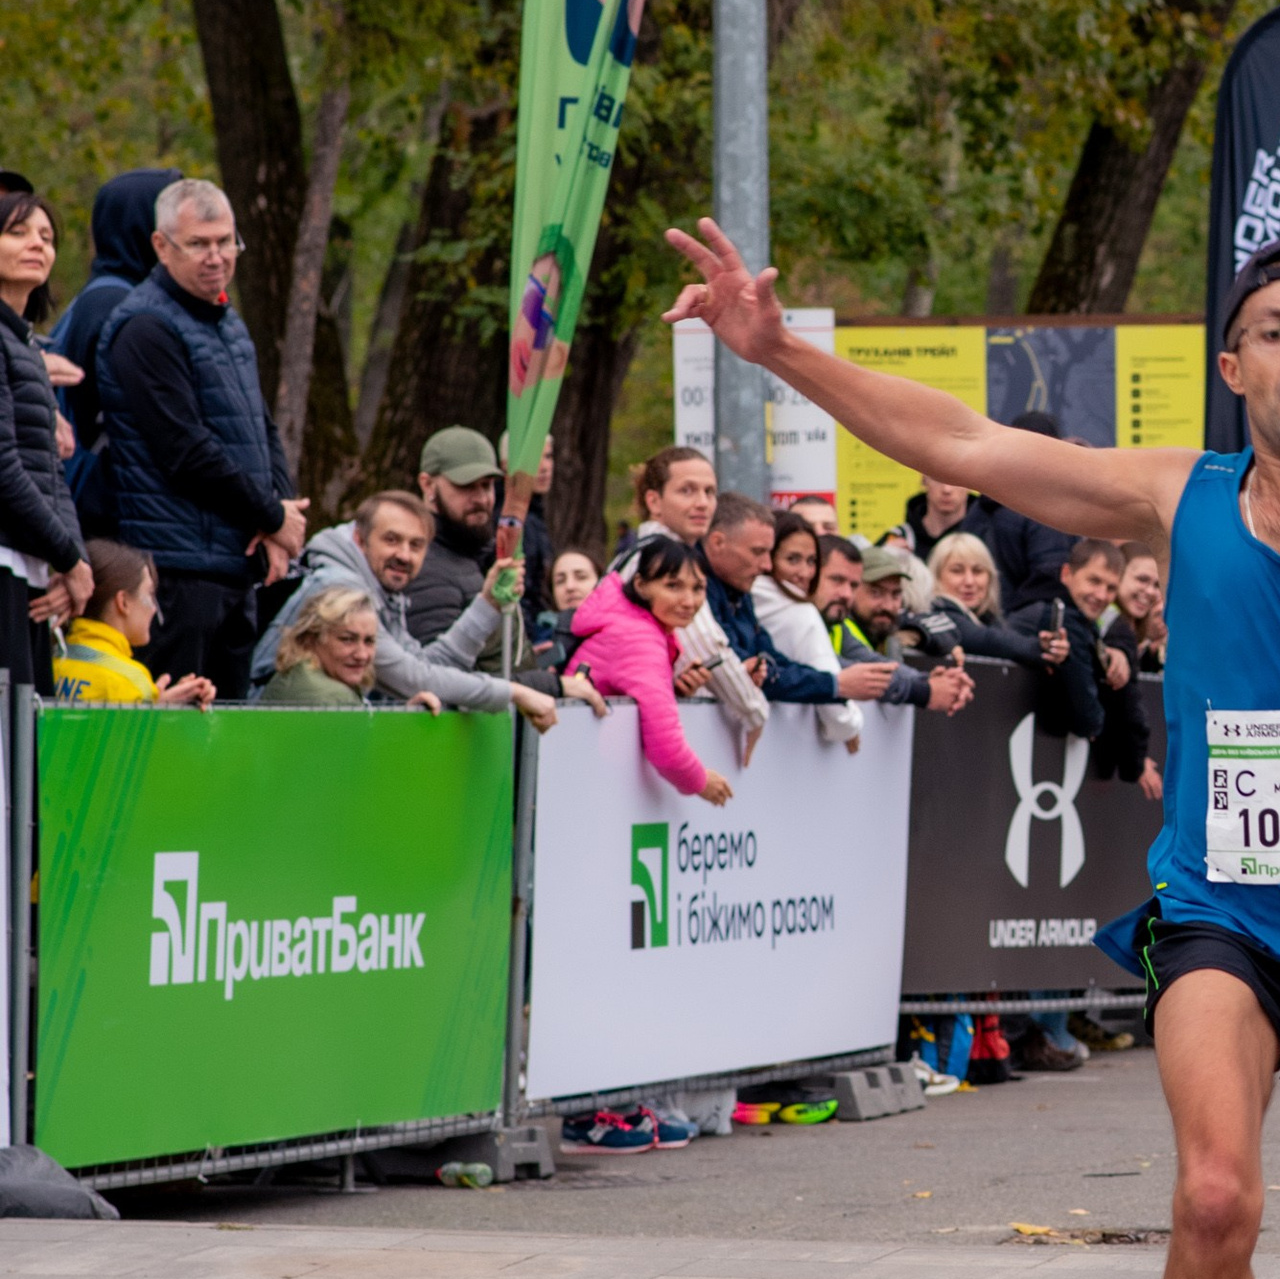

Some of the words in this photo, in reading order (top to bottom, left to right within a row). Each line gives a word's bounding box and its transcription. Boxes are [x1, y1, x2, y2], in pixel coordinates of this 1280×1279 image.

[1234, 148, 1277, 275] NDER
[676, 821, 757, 884] беремо
[198, 896, 427, 1001] ПриватБанк
[676, 904, 682, 946] і
[688, 892, 766, 945] біжимо
[772, 894, 834, 951] разом
[989, 918, 1036, 948] UNDER
[1037, 918, 1097, 947] ARMOUR
